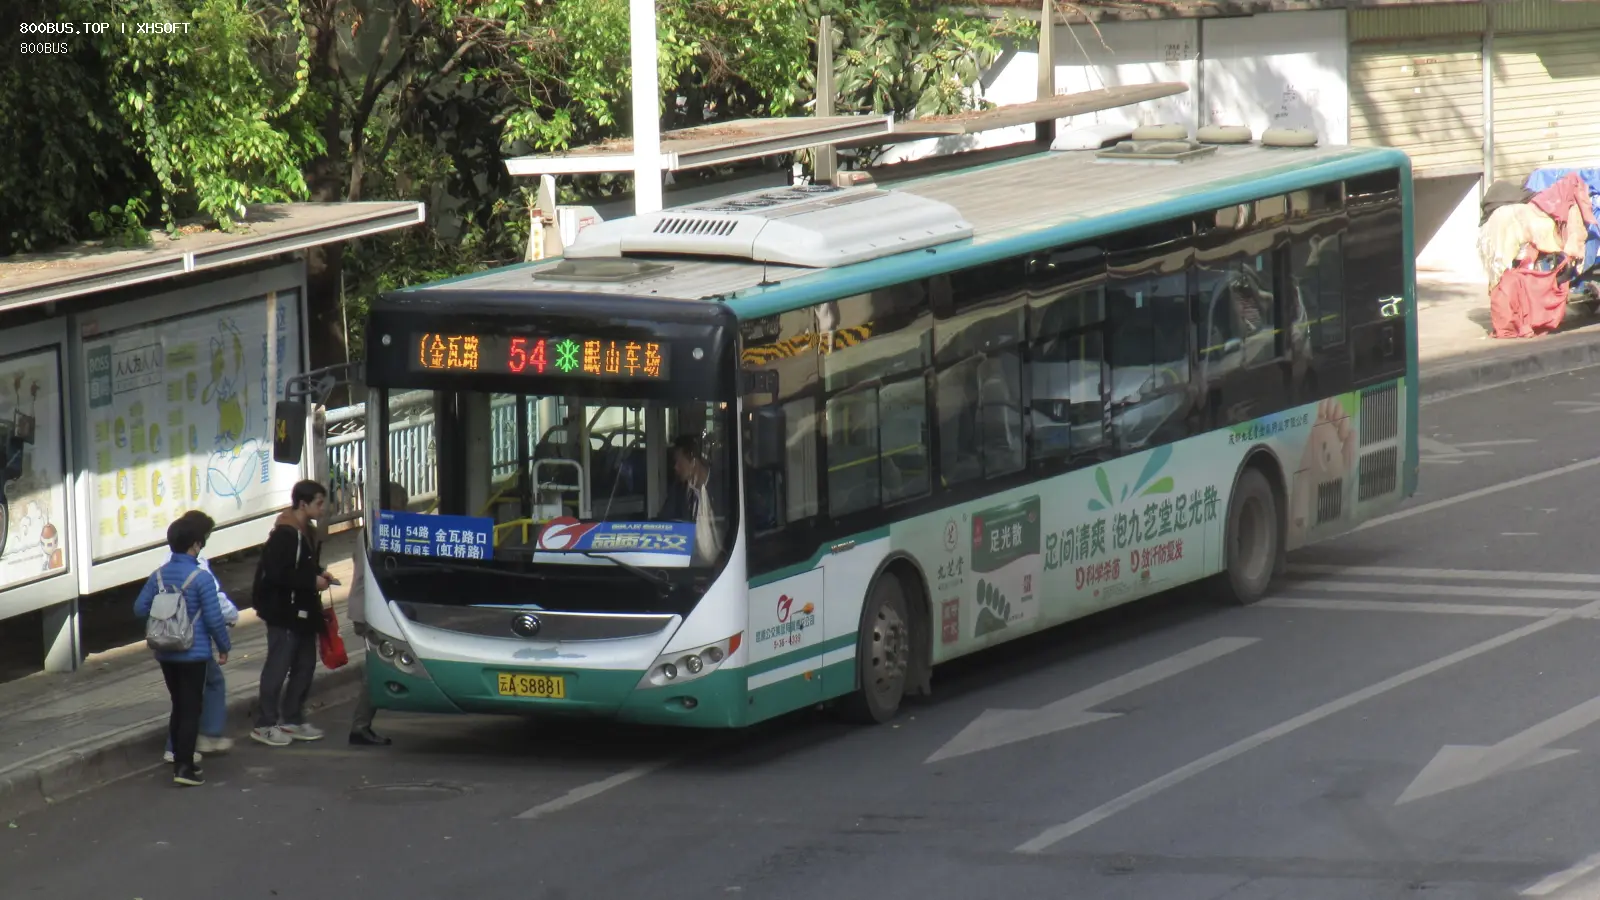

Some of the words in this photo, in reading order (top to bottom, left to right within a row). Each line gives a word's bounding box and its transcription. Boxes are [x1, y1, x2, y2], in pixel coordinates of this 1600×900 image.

[508, 336, 547, 373] 54
[435, 528, 487, 545] 金瓦路口
[989, 522, 1023, 553] 足光散
